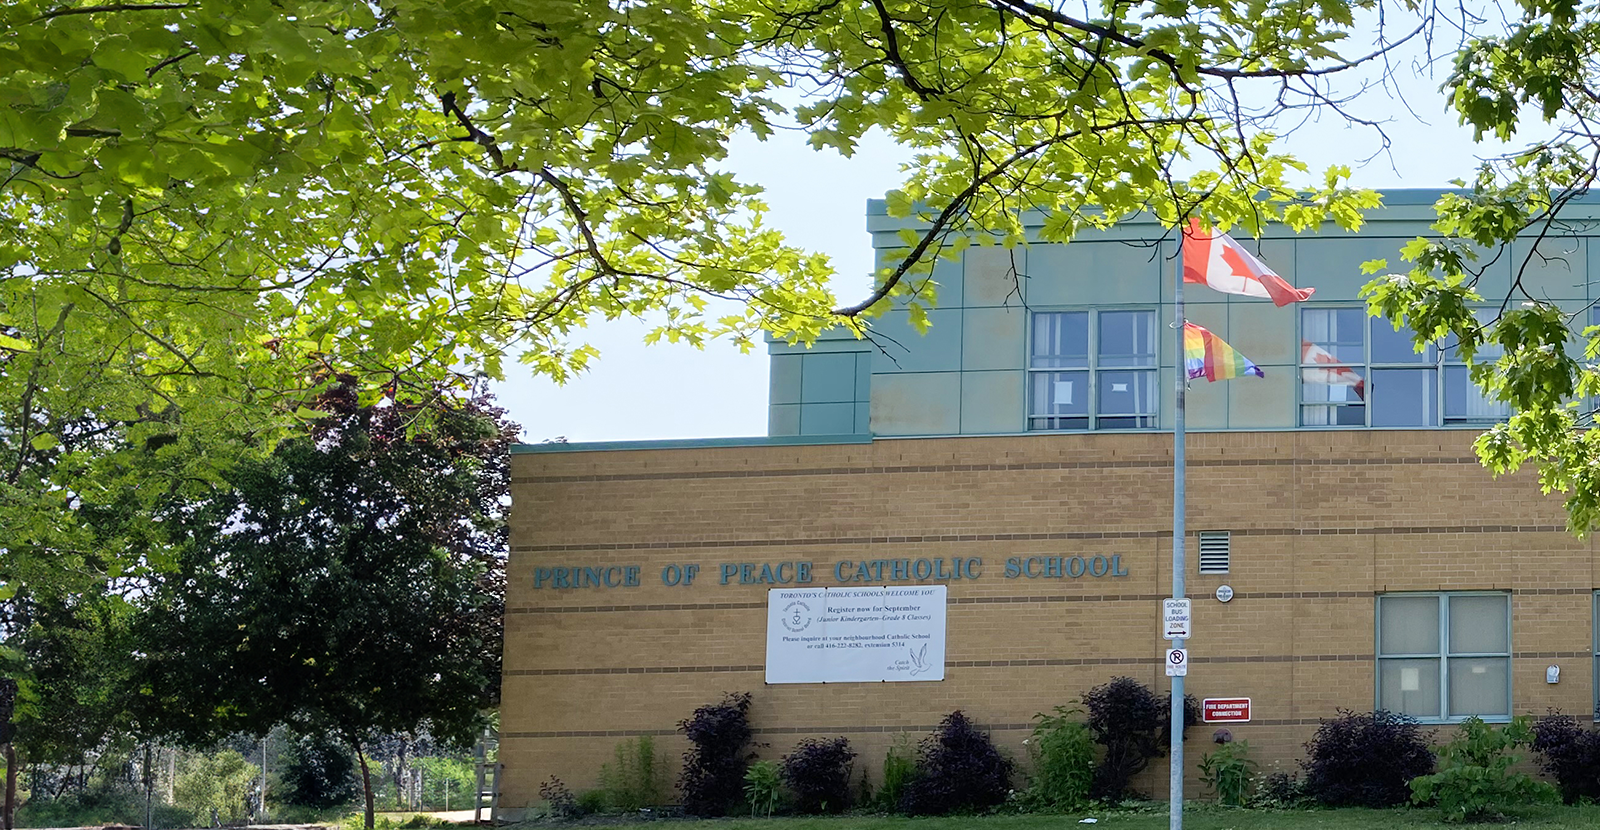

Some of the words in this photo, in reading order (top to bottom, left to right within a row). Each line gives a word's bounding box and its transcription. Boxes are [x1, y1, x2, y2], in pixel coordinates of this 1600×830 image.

[534, 565, 641, 589] PRINCE
[661, 564, 700, 587] OF
[720, 561, 813, 585] PEACE
[834, 557, 982, 582] CATHOLIC
[1004, 555, 1129, 579] SCHOOL
[827, 606, 856, 614] Register
[884, 605, 921, 613] September
[843, 634, 886, 642] neighbourhood
